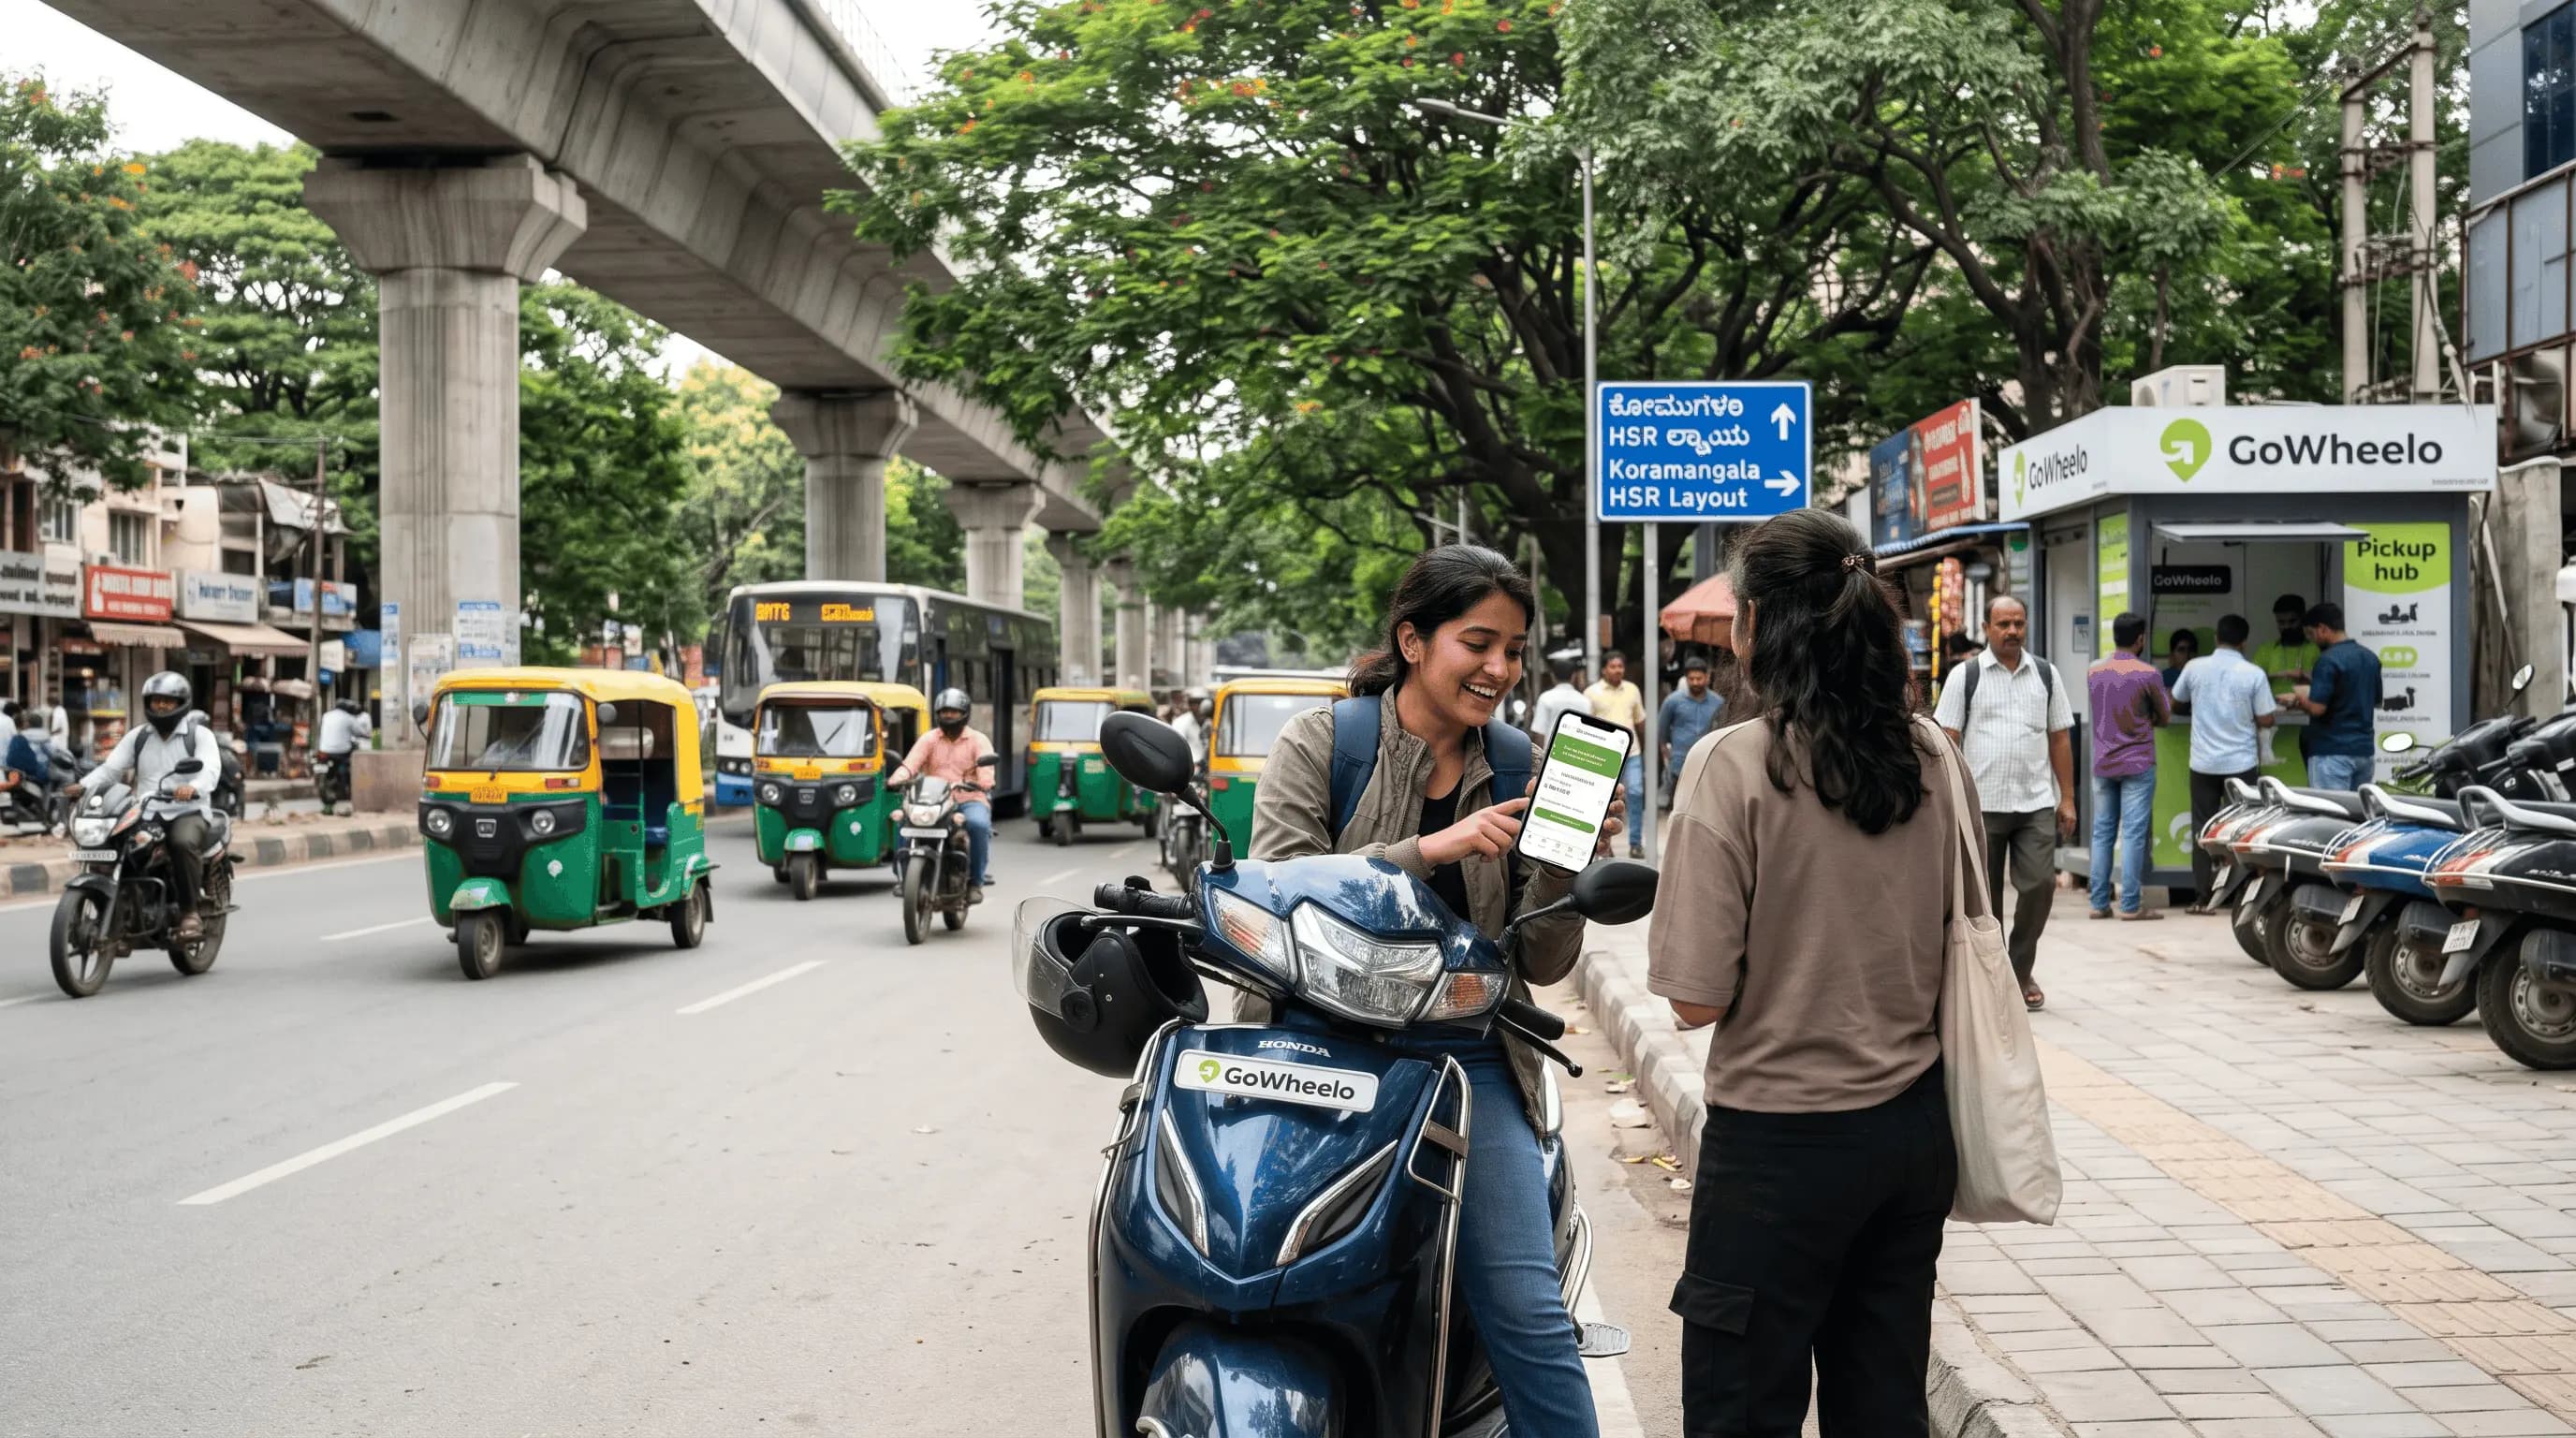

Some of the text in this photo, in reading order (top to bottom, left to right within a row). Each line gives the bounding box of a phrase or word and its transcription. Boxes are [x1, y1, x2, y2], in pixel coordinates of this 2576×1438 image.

[1609, 425, 1658, 447] HSR
[2229, 433, 2443, 465] GoWheelo
[1609, 458, 1761, 484] Koramangala
[2029, 443, 2087, 490] GoWheelo
[1609, 486, 1748, 511] HSR Layout
[2357, 538, 2437, 562] Pickup
[2154, 573, 2222, 586] GoWheelo
[2375, 563, 2419, 580] hub
[1258, 1040, 1331, 1058] HONDA
[1224, 1066, 1354, 1100] GoWheelo
